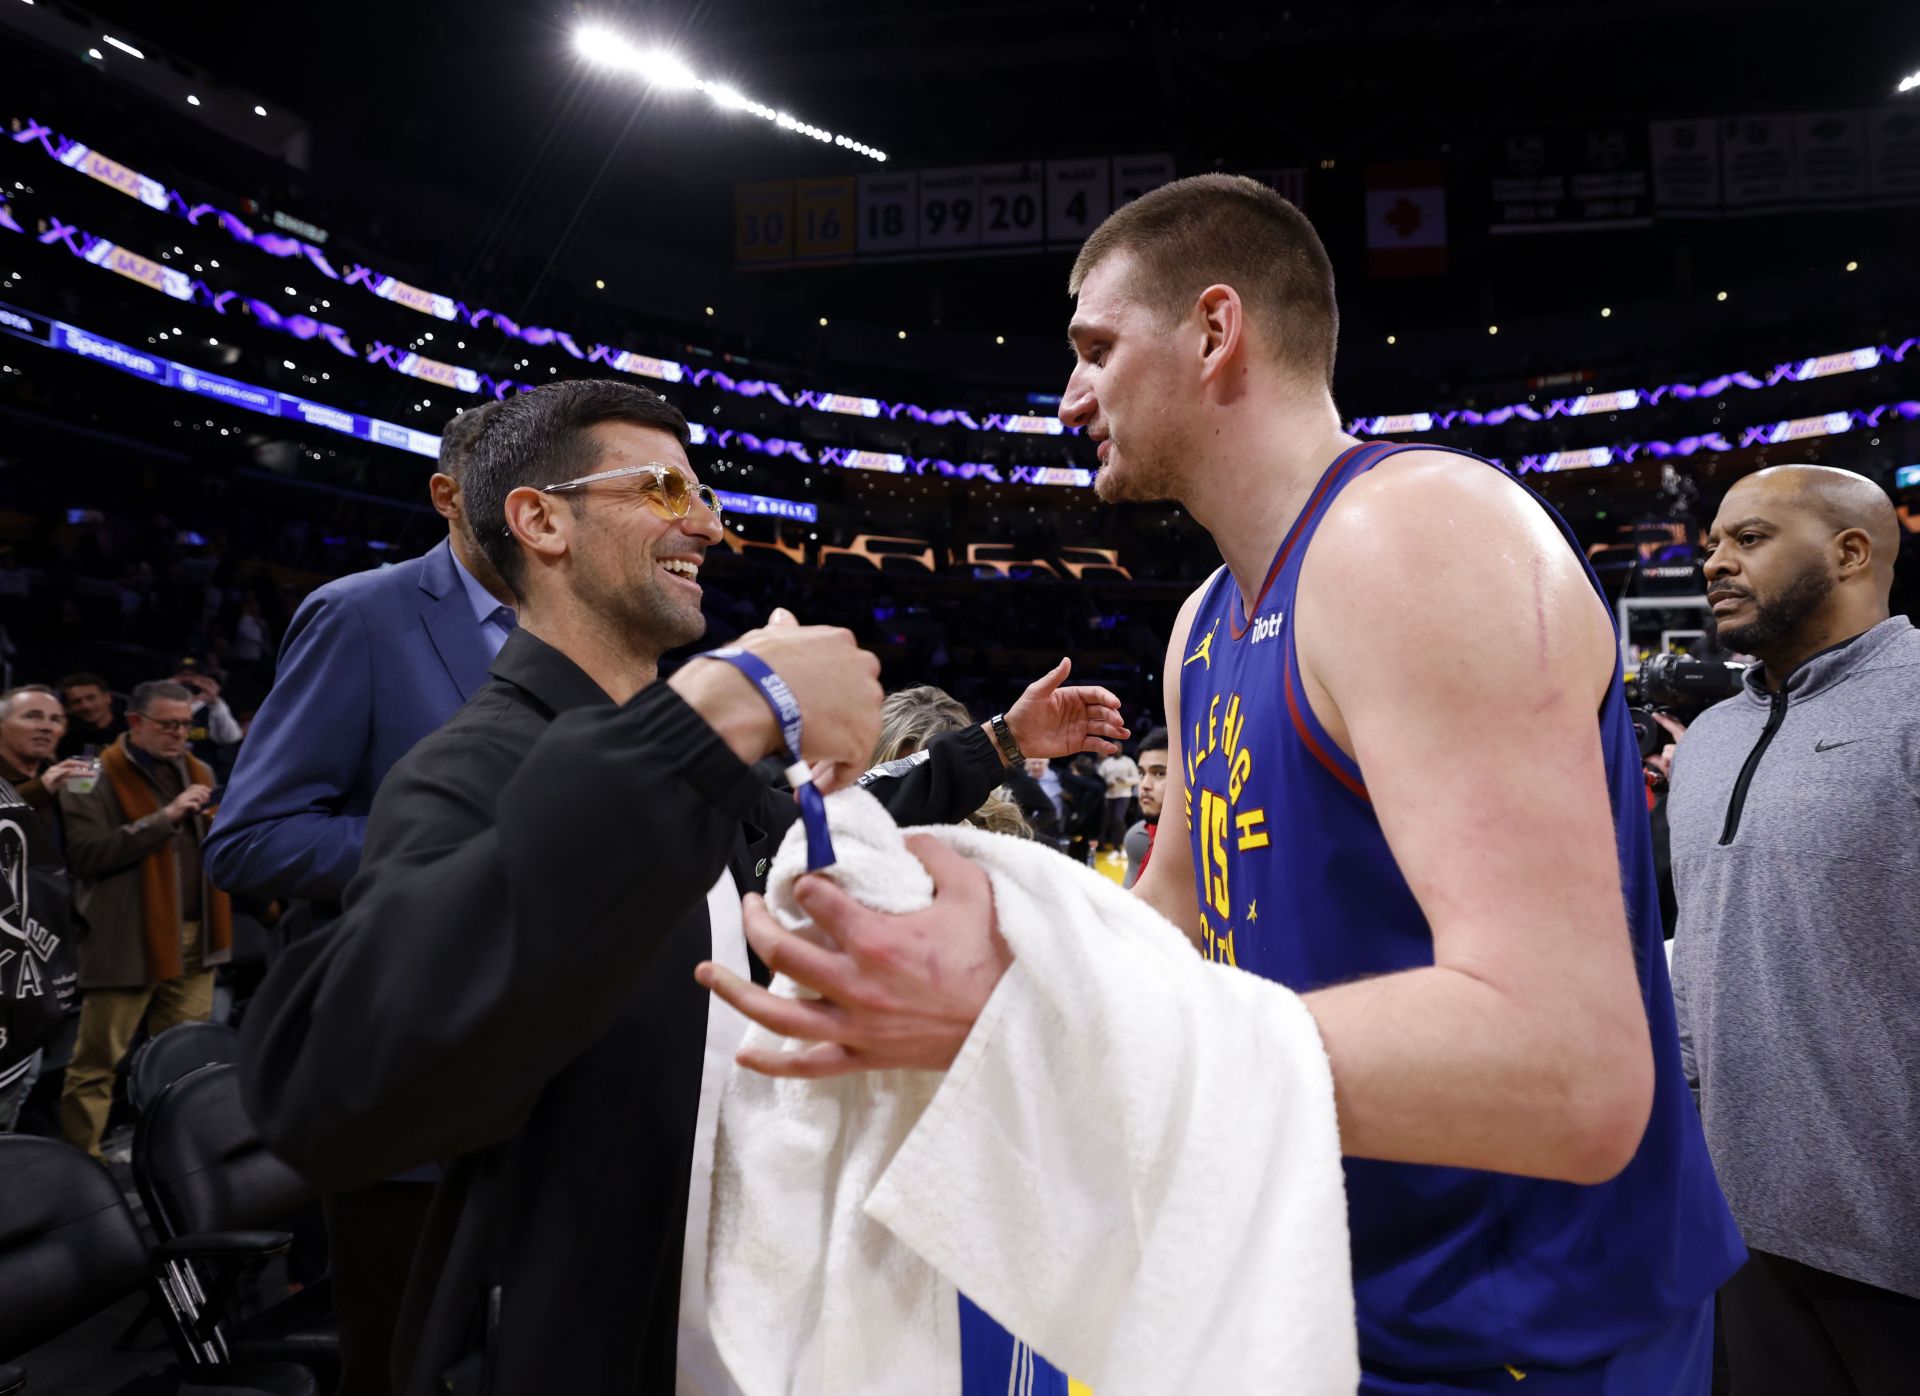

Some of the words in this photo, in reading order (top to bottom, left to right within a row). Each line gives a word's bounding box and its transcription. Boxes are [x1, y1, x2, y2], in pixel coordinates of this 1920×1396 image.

[805, 208, 842, 242] 16
[867, 203, 904, 238] 18
[925, 197, 974, 234] 99
[989, 194, 1036, 230] 20
[1066, 190, 1089, 226] 4
[742, 211, 785, 246] 30
[64, 330, 157, 375] Spectrum
[769, 502, 813, 518] DELTA
[1200, 789, 1231, 921] 15
